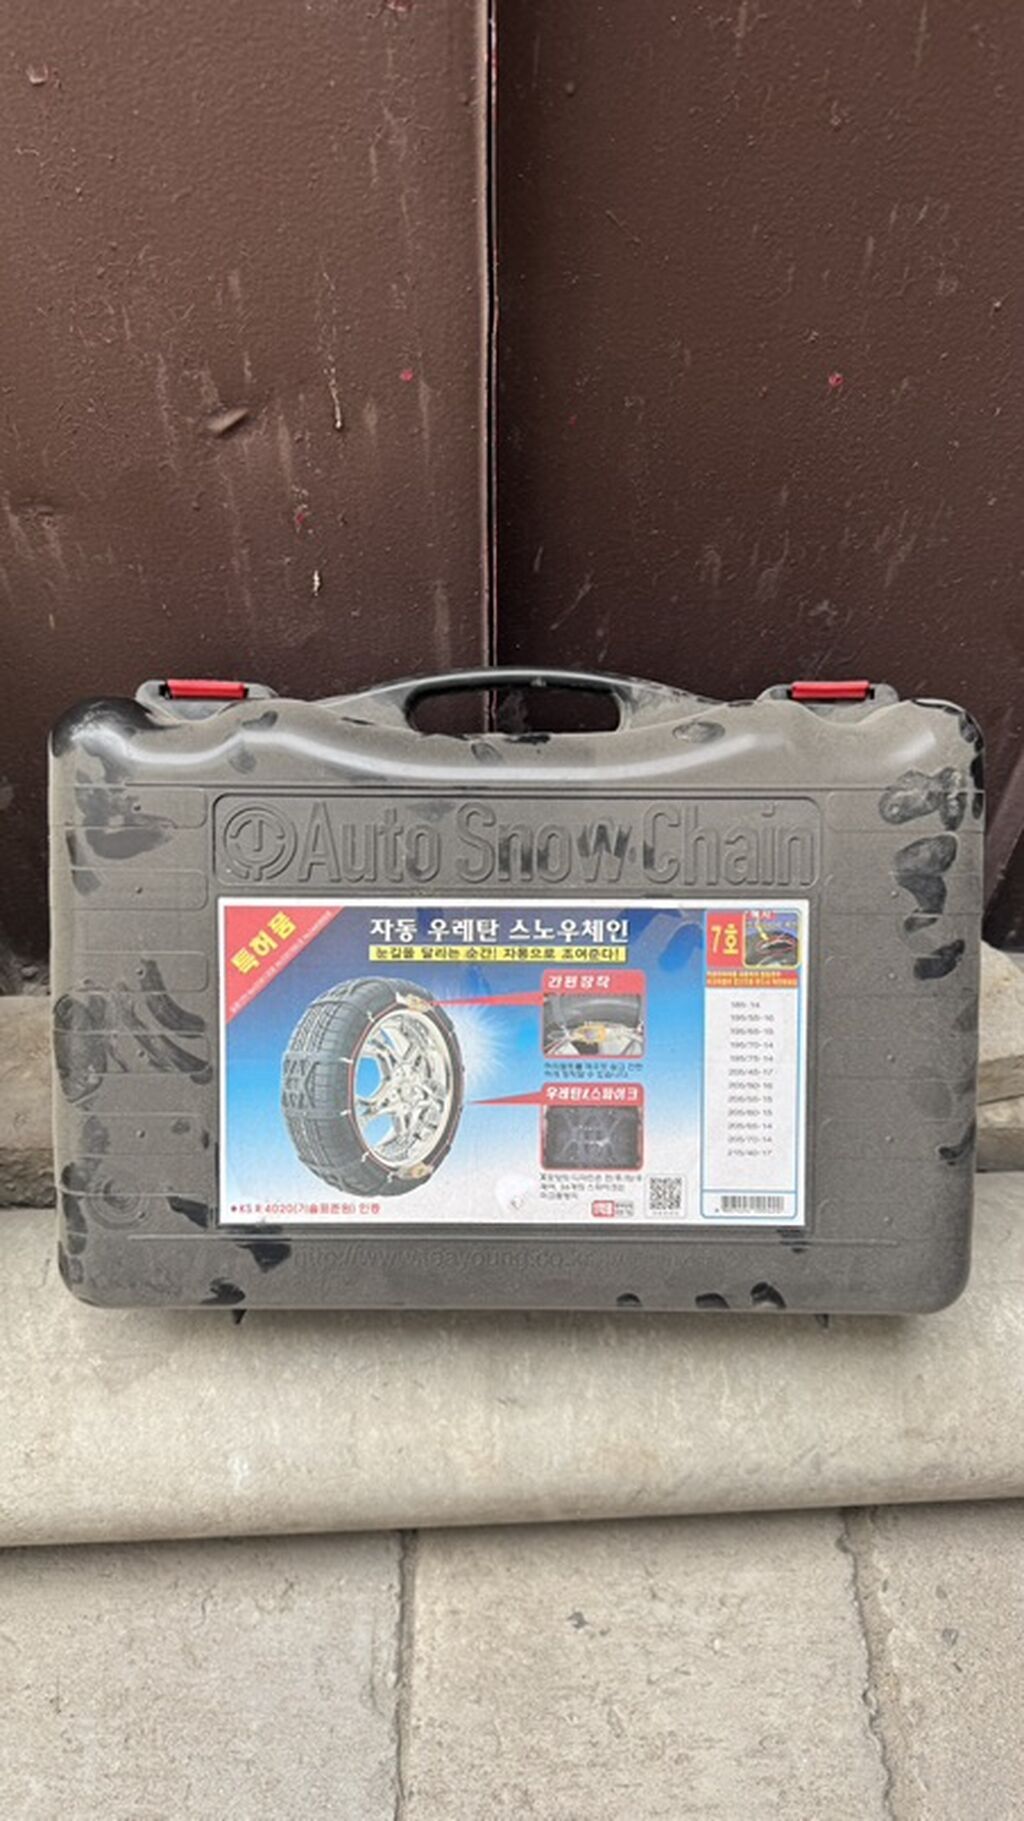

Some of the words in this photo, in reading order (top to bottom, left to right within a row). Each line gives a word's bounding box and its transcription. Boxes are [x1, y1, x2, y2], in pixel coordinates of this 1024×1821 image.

[300, 801, 441, 884] Auto
[455, 803, 632, 885] Snow
[641, 804, 816, 886] Chain
[369, 917, 418, 943] 자동
[427, 917, 500, 944] 우레탄
[508, 917, 629, 944] 스노우체인
[710, 923, 739, 956] 7호
[375, 946, 416, 960] 눈길을
[421, 946, 461, 960] 달리는
[465, 946, 498, 960] 순간!
[502, 946, 556, 960] 자동으로
[561, 946, 620, 960] 조여준다!
